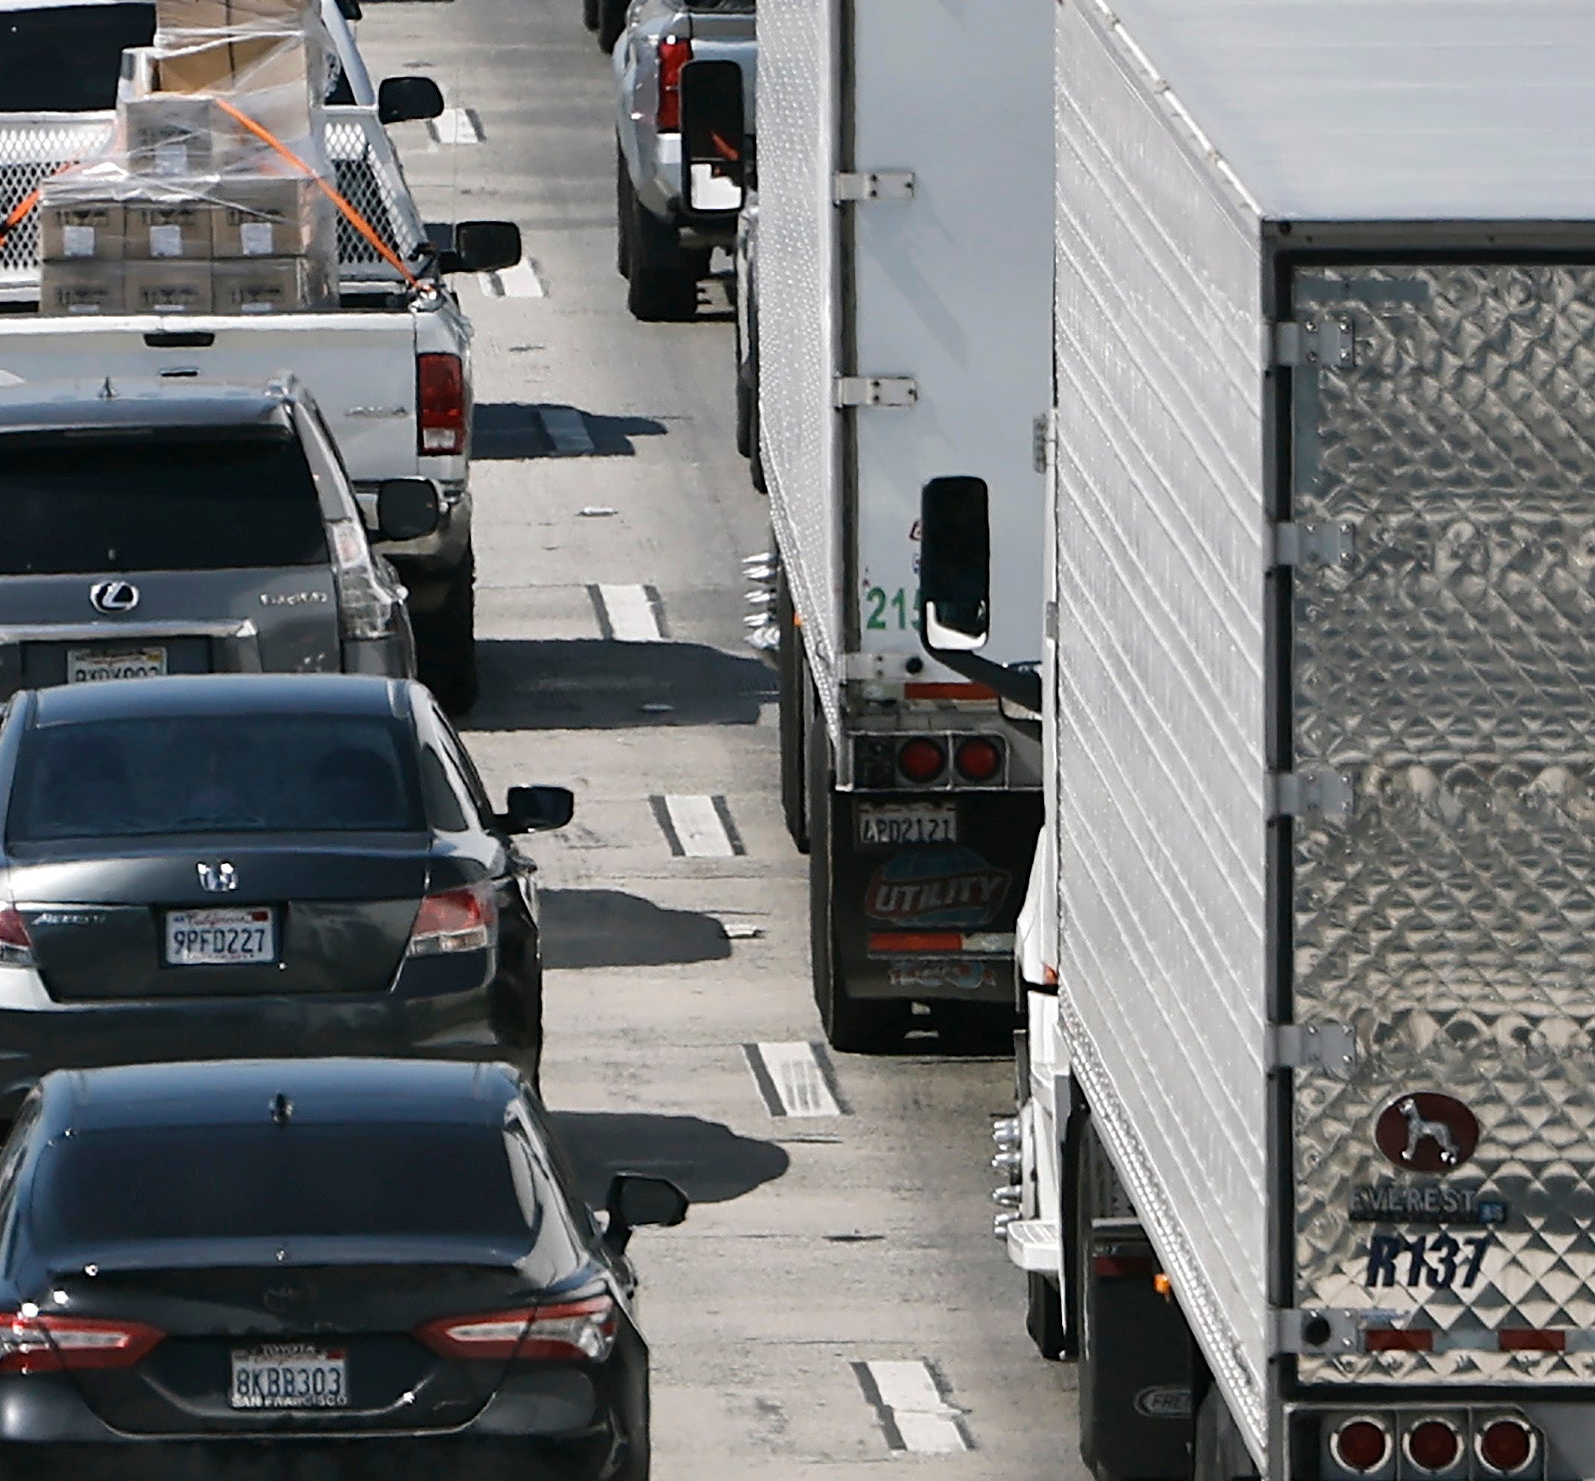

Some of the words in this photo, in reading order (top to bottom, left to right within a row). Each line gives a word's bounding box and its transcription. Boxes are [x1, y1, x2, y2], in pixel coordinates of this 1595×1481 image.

[873, 874, 1007, 912] UTILITY
[173, 928, 266, 957] 9PFD227
[1350, 1186, 1476, 1212] EVEREST
[1365, 1230, 1494, 1289] R137
[235, 1367, 343, 1396] 8KBB303
[231, 1395, 262, 1408] SAN
[265, 1394, 348, 1408] FRANCISCO
